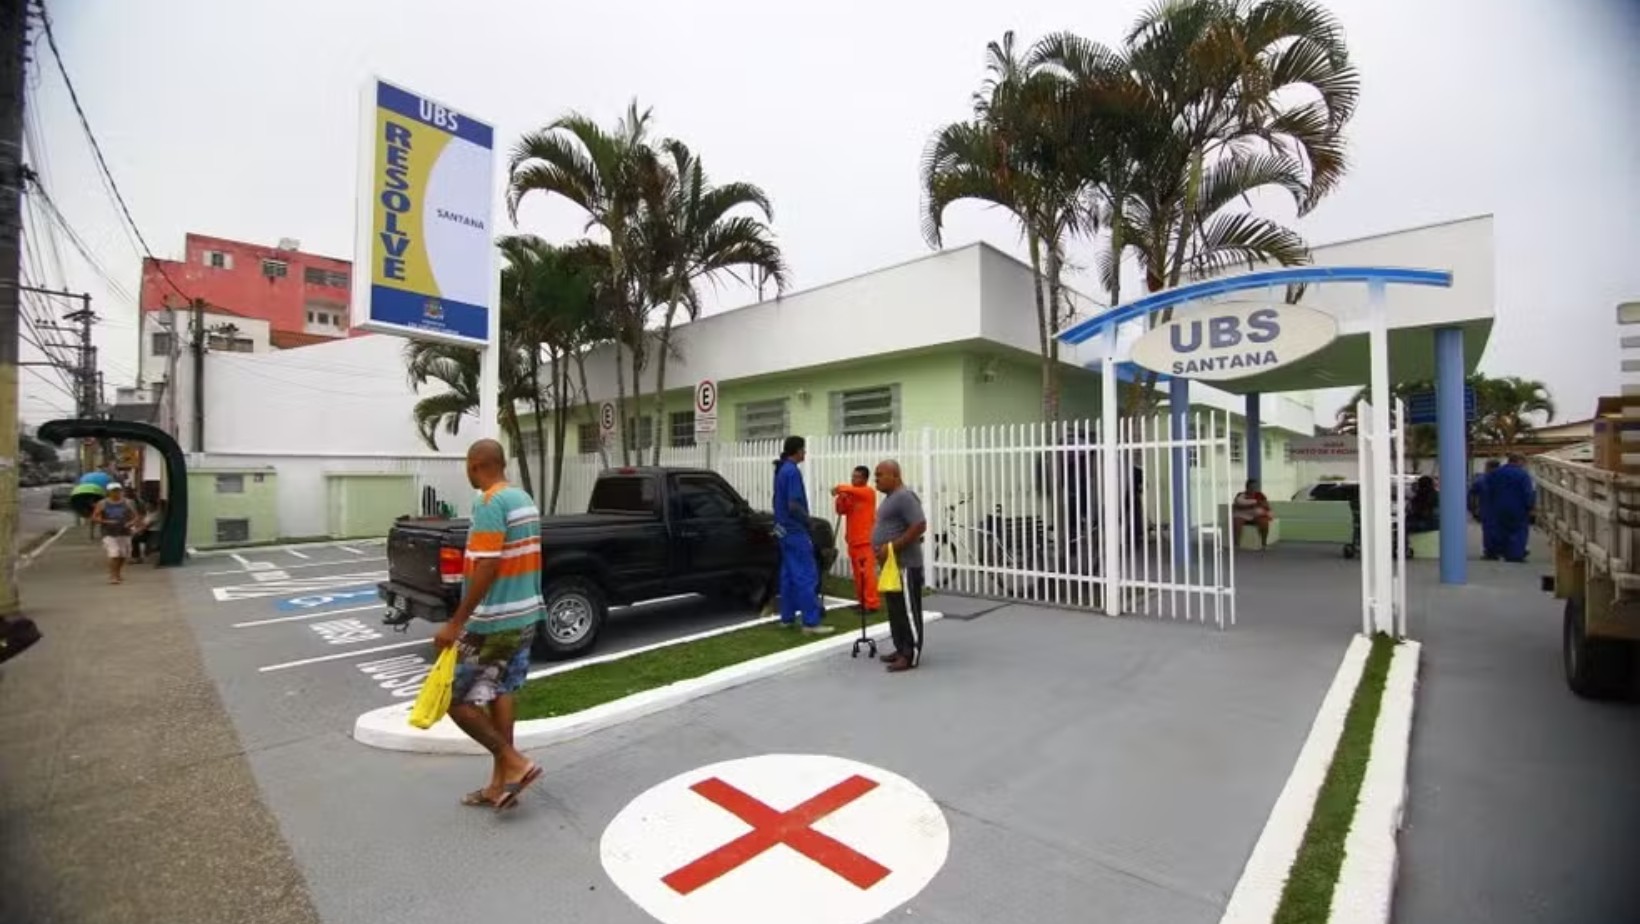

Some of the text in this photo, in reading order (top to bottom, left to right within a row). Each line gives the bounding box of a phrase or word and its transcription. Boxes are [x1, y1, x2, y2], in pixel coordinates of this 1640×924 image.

[419, 99, 459, 132] UBS
[380, 121, 412, 281] RESOLVE
[436, 208, 484, 230] SANTANA
[1170, 308, 1281, 354] UBS
[1172, 350, 1279, 375] SANTANA
[702, 387, 710, 406] E
